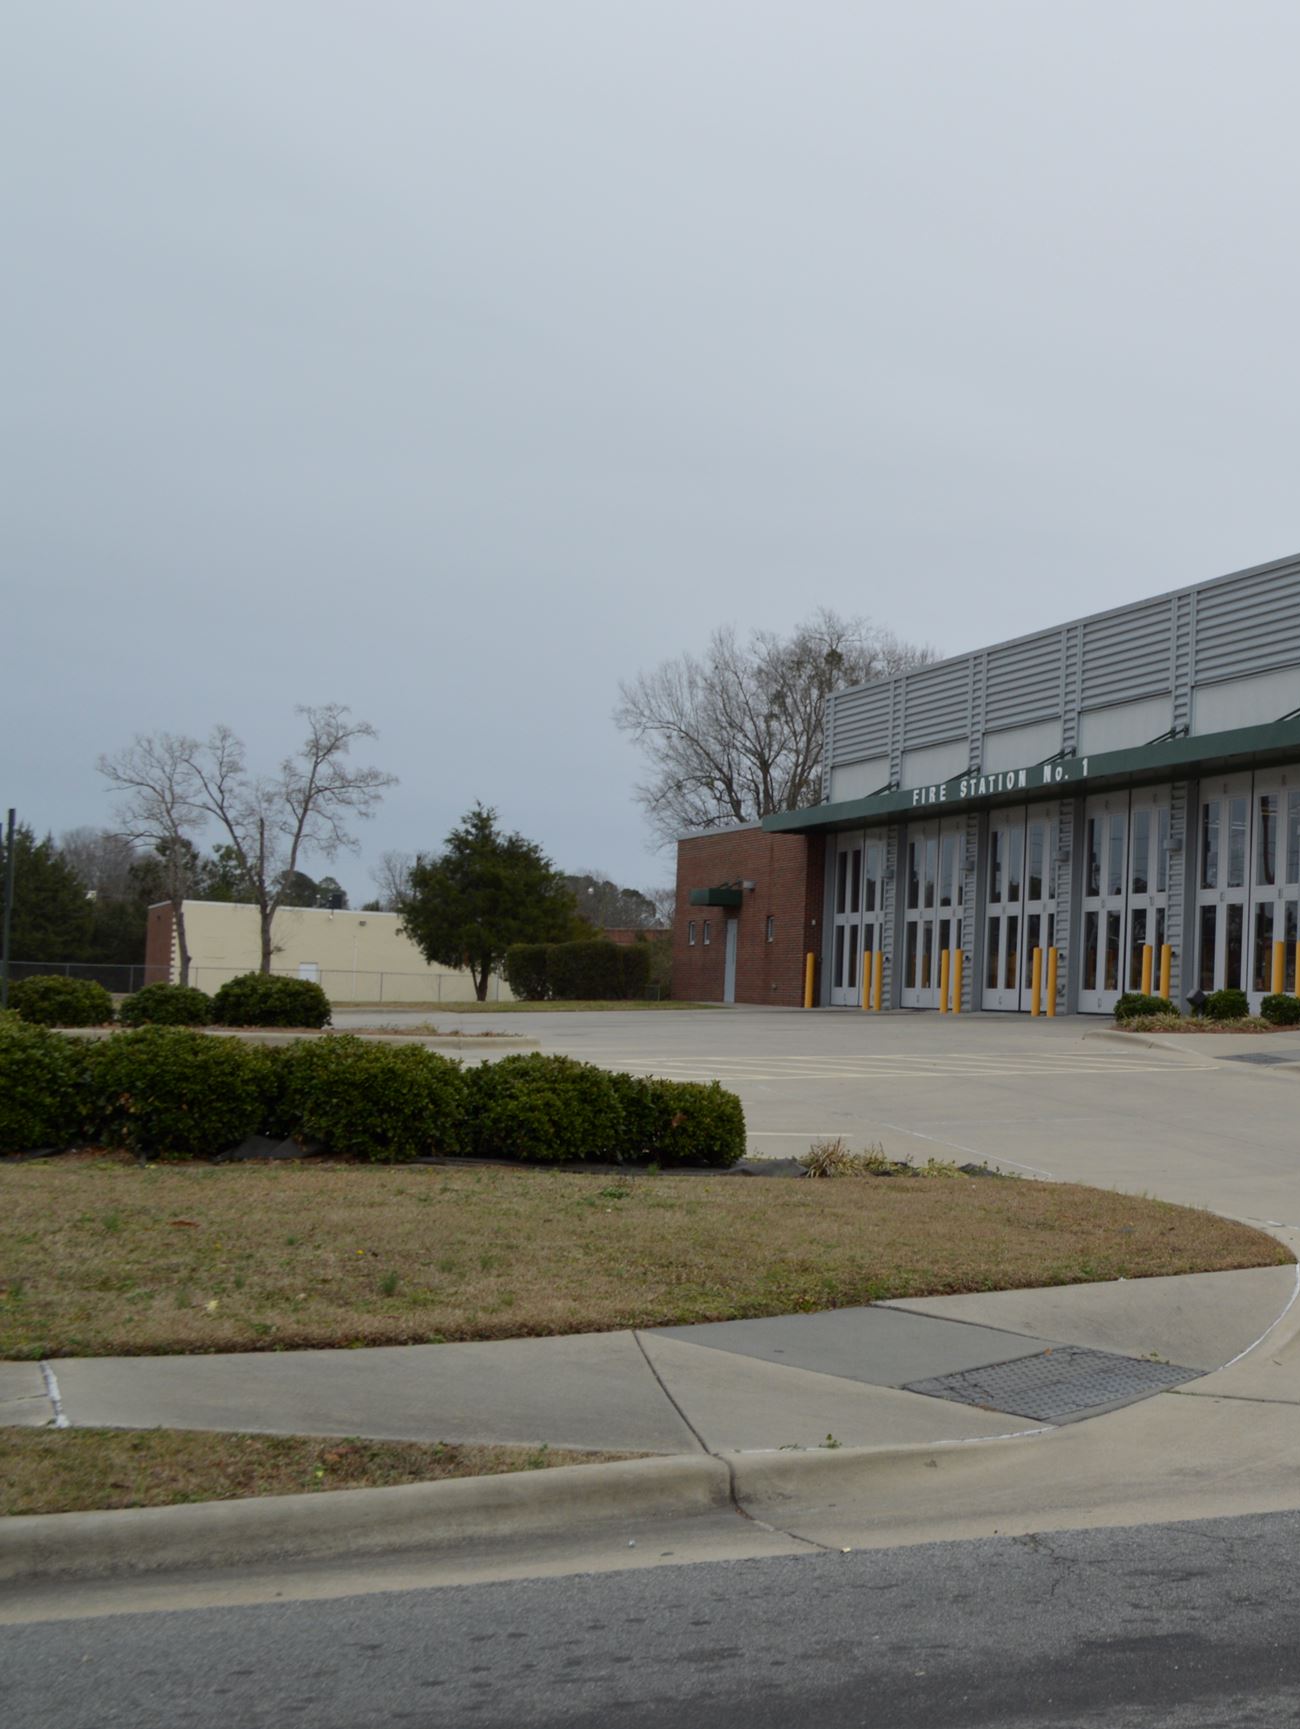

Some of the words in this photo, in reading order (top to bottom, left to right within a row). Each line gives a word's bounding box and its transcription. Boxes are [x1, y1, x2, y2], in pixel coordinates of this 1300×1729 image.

[912, 784, 947, 805] FIRE
[960, 769, 1027, 798] STATION
[1043, 764, 1069, 783] No.
[1082, 757, 1089, 777] 1
